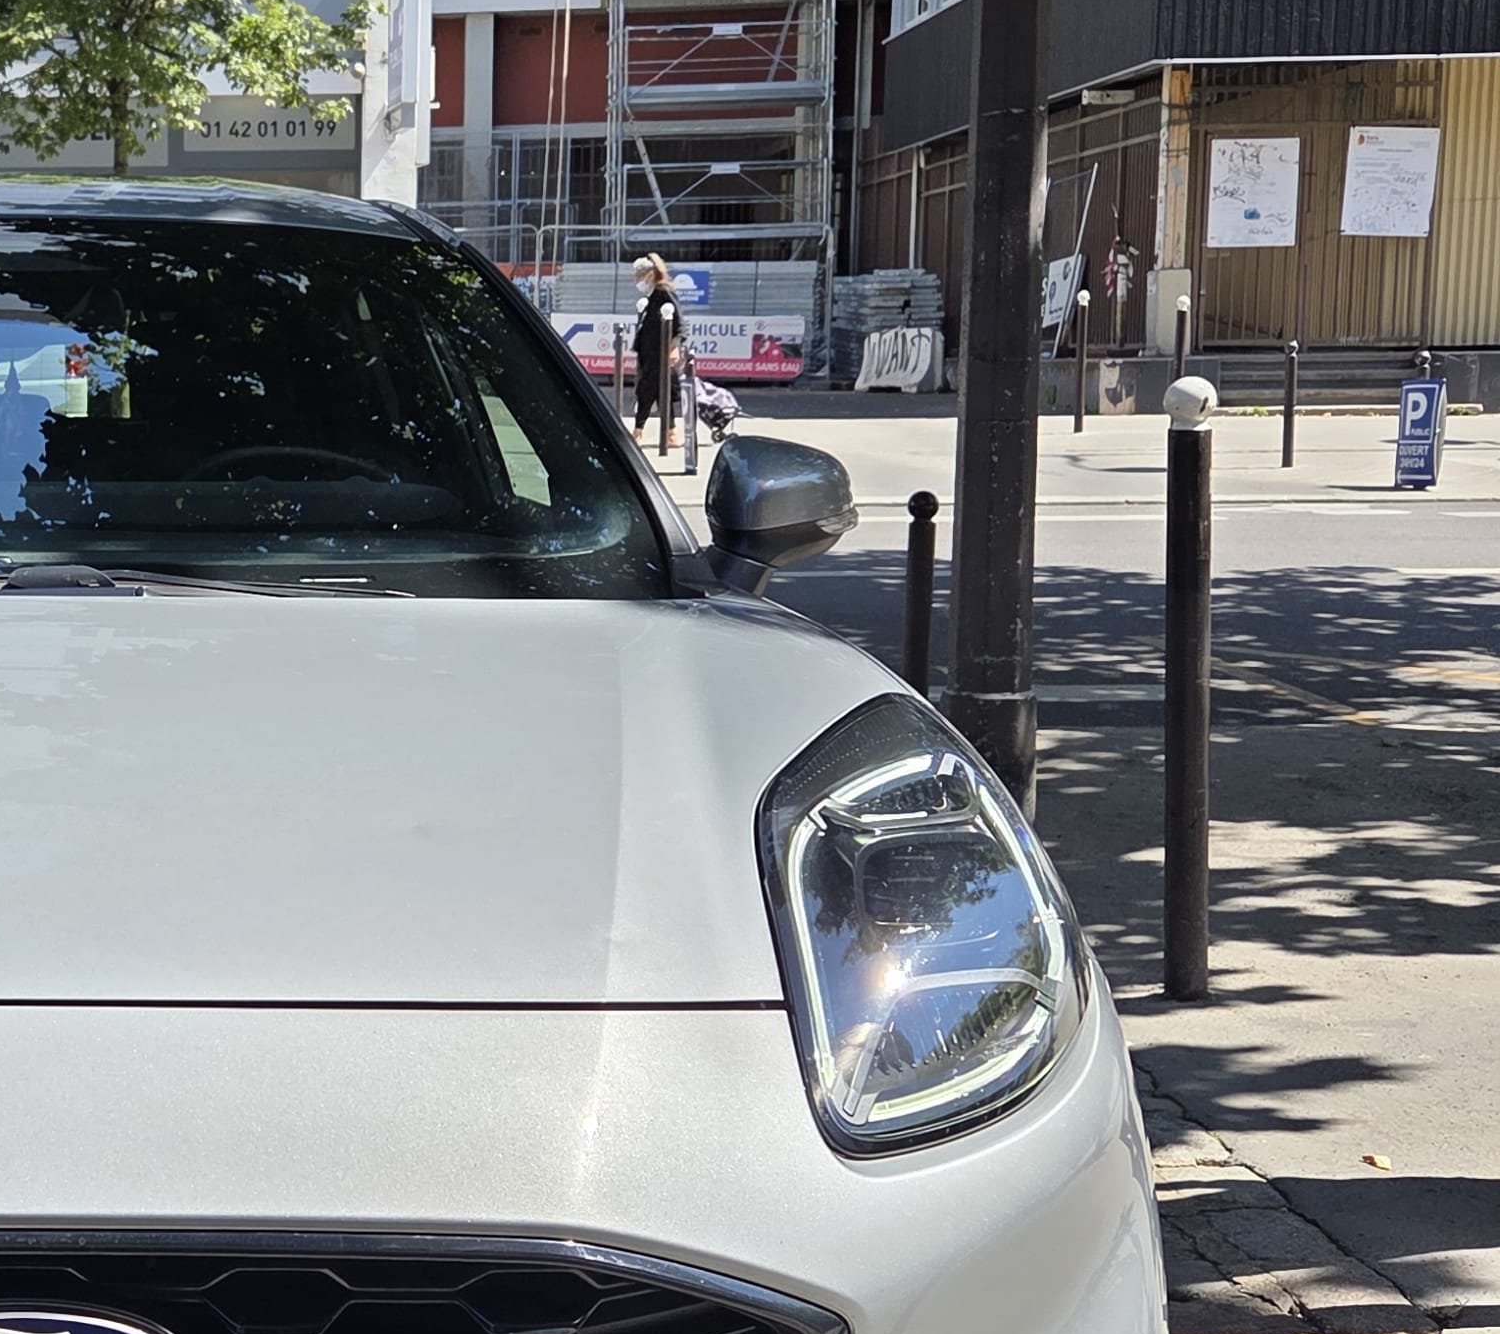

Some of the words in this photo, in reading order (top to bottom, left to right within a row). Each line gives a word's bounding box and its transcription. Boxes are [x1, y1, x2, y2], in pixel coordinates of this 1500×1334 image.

[229, 121, 252, 138] 42
[257, 120, 278, 137] 01
[286, 120, 306, 137] 01
[314, 120, 337, 137] 99
[1405, 392, 1428, 436] P
[1399, 445, 1430, 456] OUVERT
